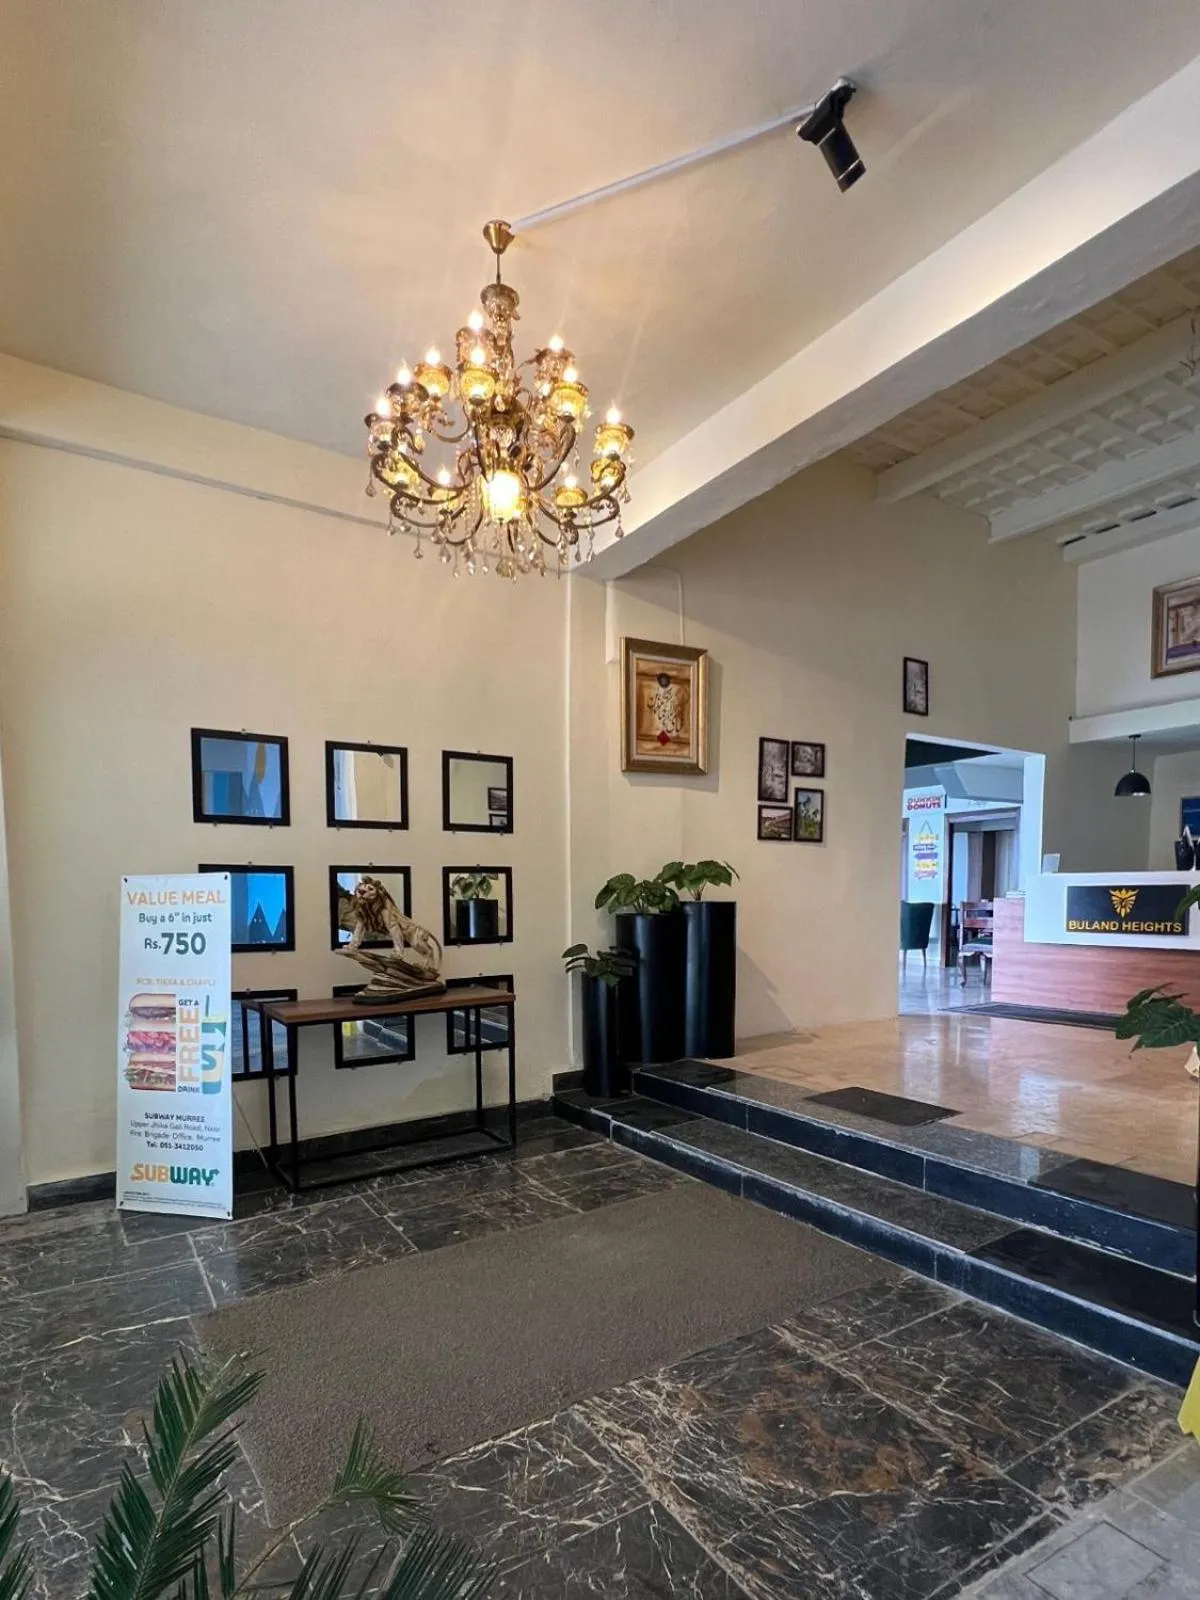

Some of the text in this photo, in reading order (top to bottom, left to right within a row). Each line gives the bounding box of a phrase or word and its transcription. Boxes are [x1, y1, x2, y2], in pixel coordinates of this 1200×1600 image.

[907, 802, 941, 811] DONUTS
[127, 889, 225, 906] VALUE MEAL
[138, 912, 158, 925] Buy
[182, 912, 191, 922] in
[192, 912, 213, 925] just
[1068, 920, 1182, 933] BULAND HEIGHTS
[180, 1007, 199, 1082] FREE
[177, 1085, 200, 1093] DRINK
[144, 1112, 206, 1123] SUBWAY MURREE
[130, 1163, 220, 1187] SUBWAY
